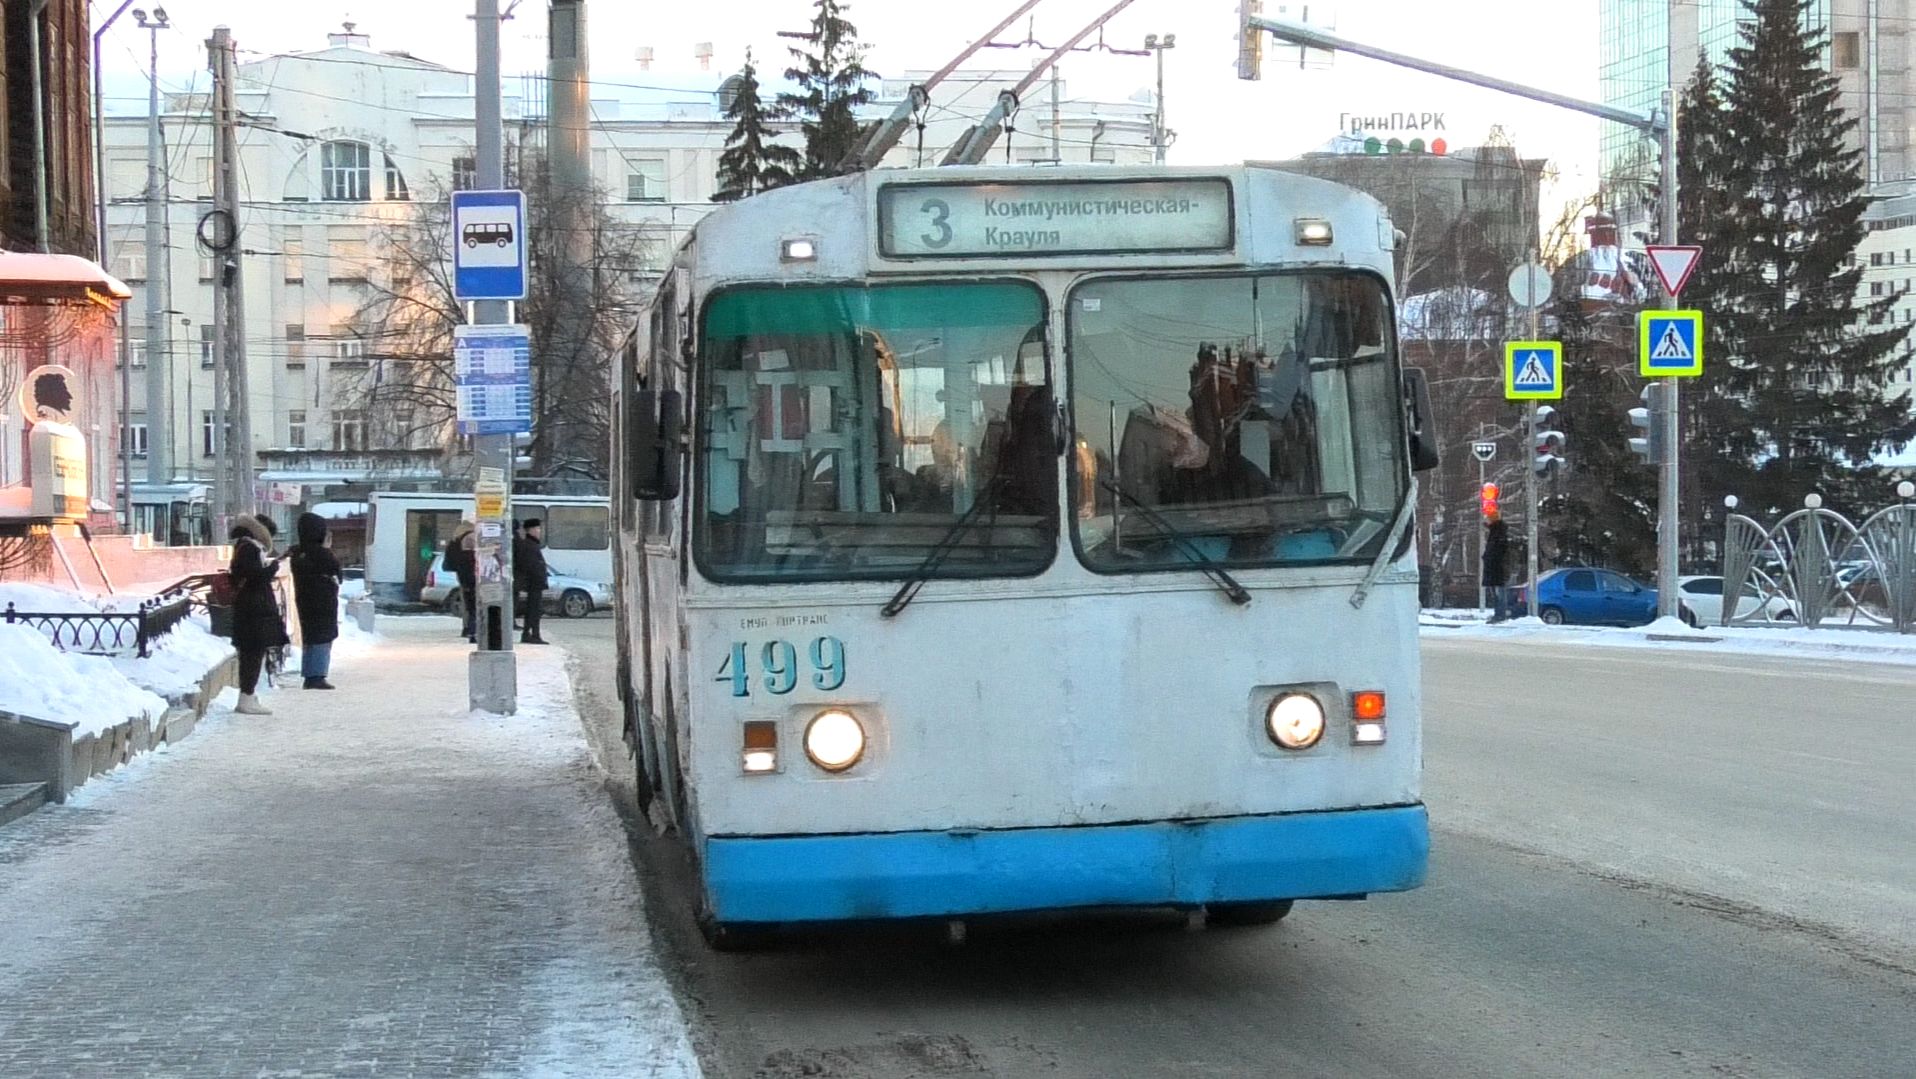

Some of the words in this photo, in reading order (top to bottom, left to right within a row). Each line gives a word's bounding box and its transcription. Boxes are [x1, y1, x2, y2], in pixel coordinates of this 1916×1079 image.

[1340, 112, 1446, 135] ГринПАРК
[920, 199, 953, 249] 3
[985, 198, 1199, 220] Коммунистическая-
[985, 227, 1060, 247] Крауля
[715, 635, 846, 697] 499
